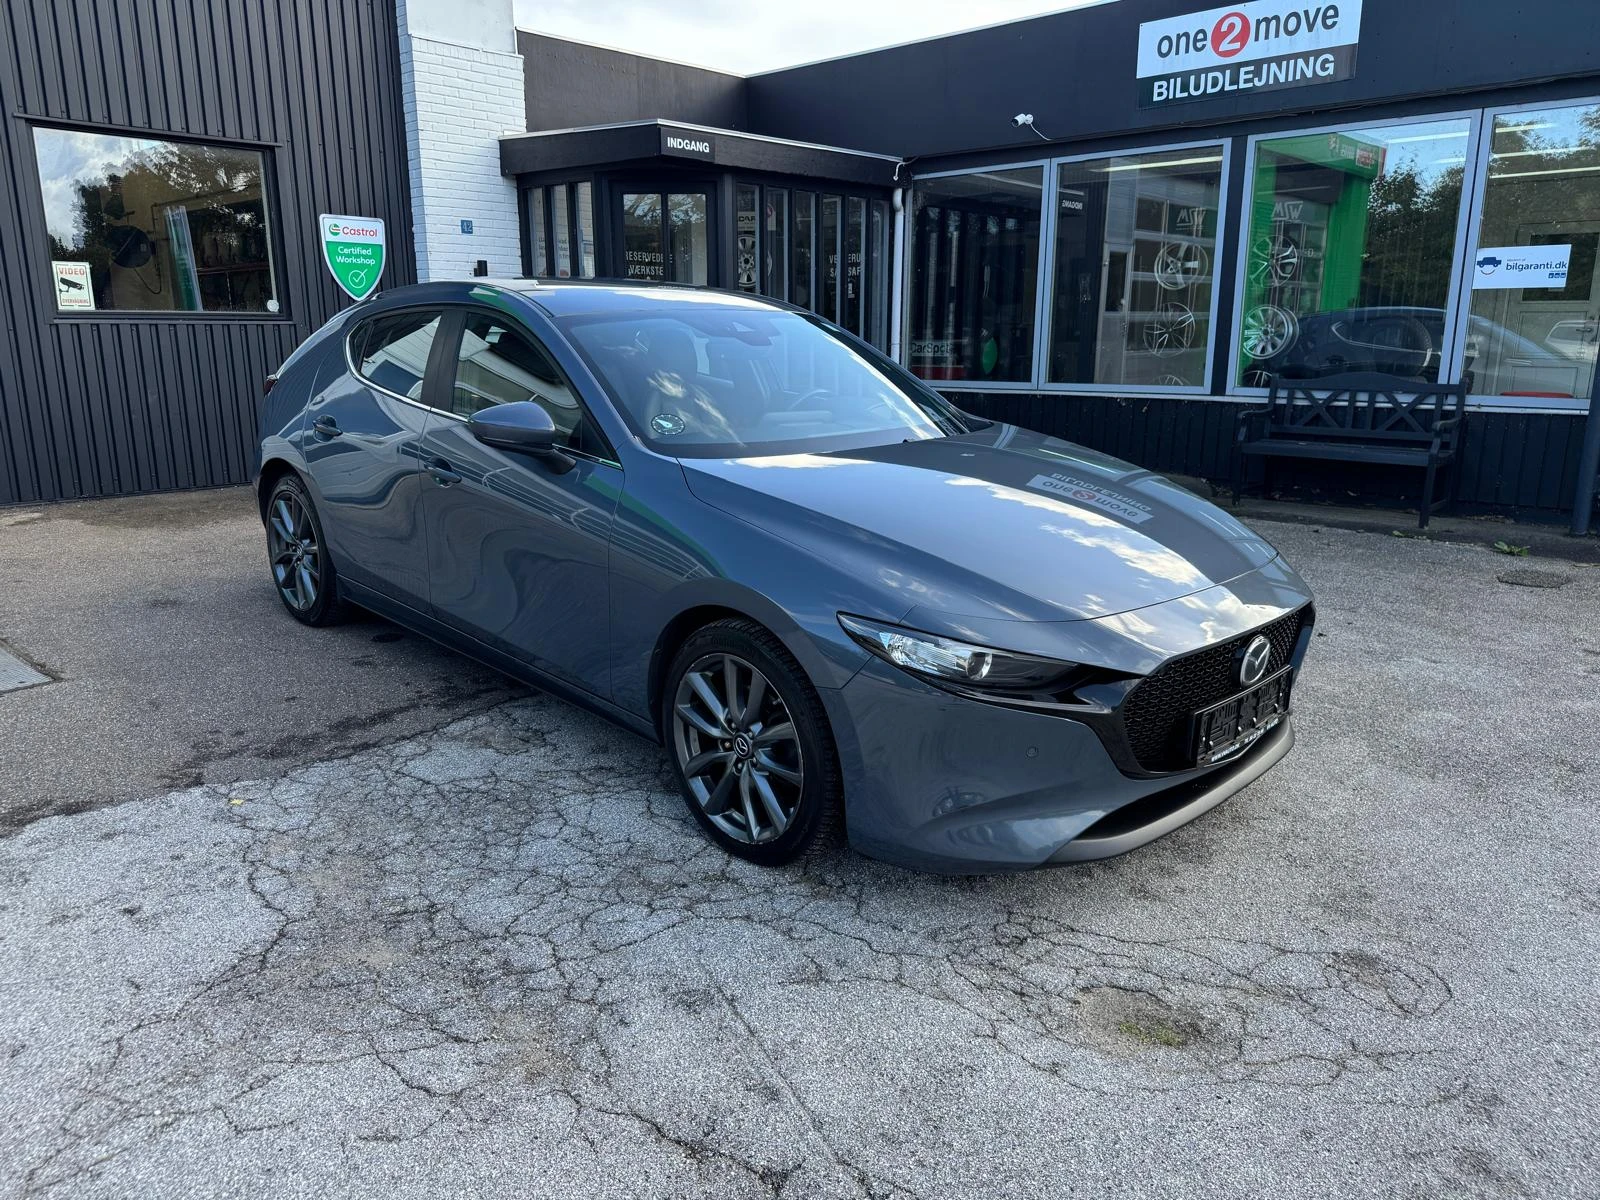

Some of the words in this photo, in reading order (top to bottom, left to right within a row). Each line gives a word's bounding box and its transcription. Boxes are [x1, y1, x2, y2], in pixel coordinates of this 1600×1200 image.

[1153, 53, 1335, 101] BILUDLEJNING
[667, 137, 710, 153] INDGANG
[342, 226, 378, 237] Castrol
[462, 221, 473, 232] 42
[337, 246, 372, 255] Certified
[335, 255, 376, 266] Workshop
[58, 267, 85, 275] VIDEO
[1505, 261, 1567, 272] bilgaranti.dk
